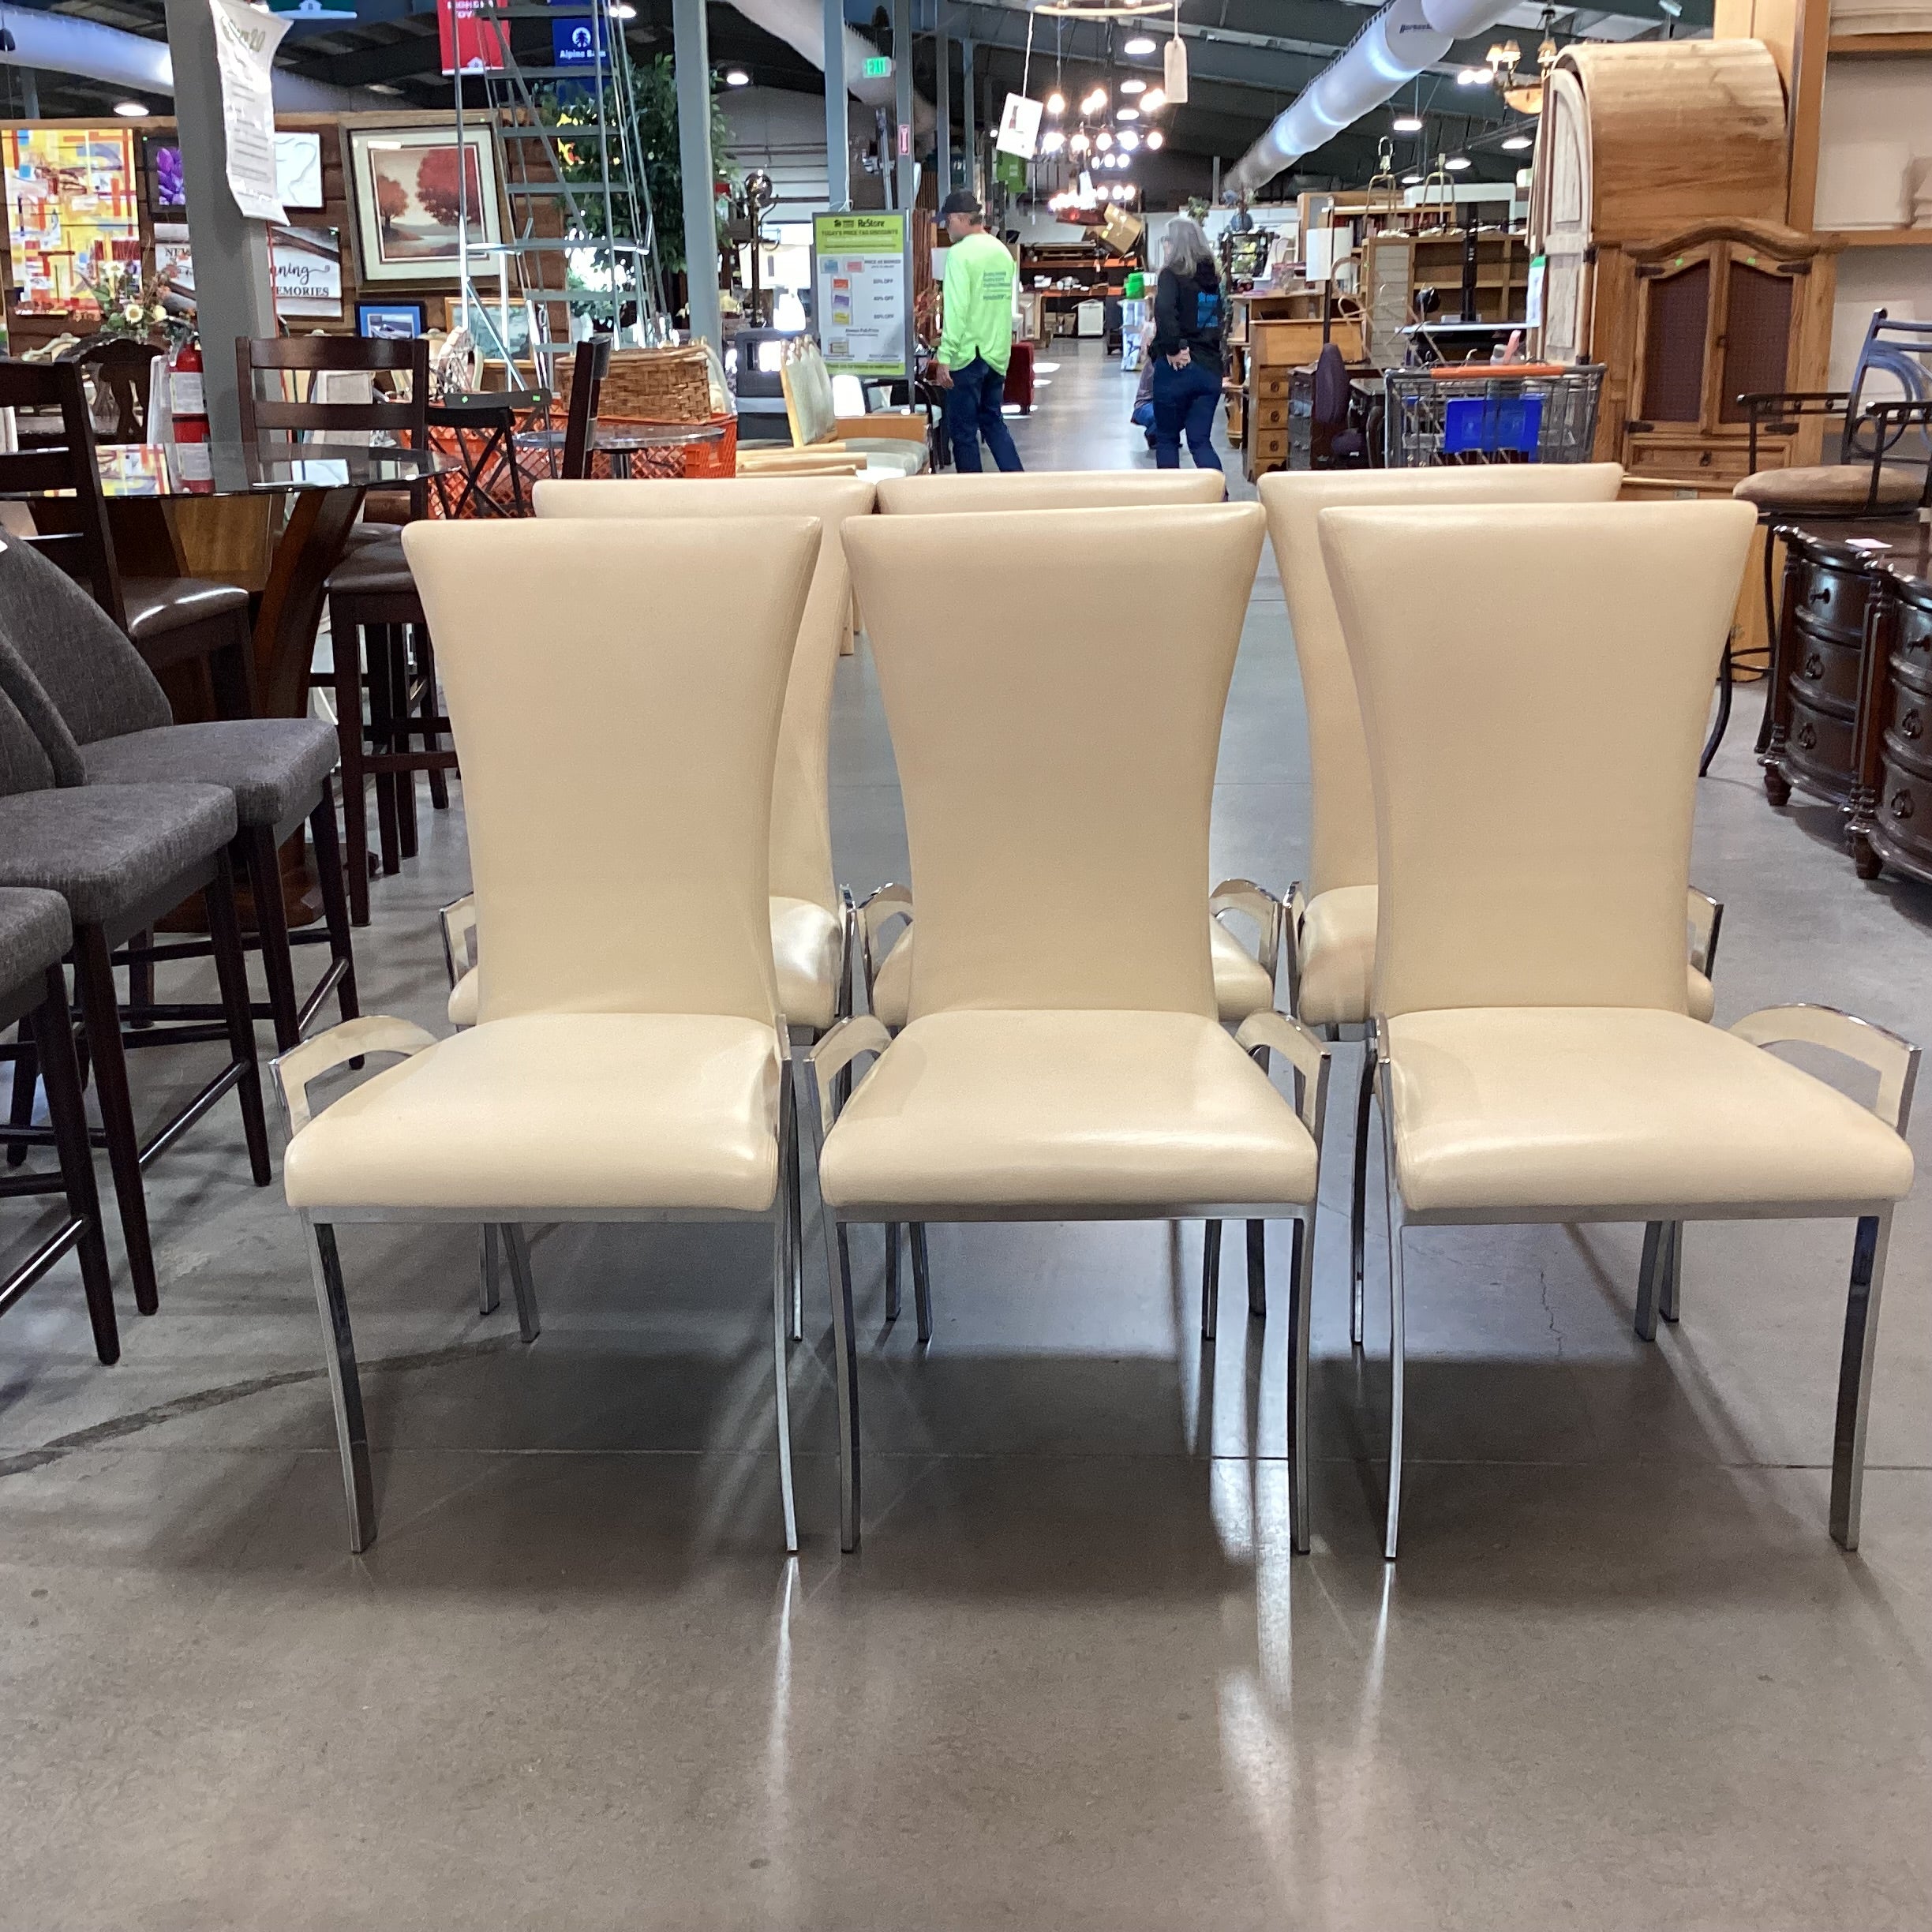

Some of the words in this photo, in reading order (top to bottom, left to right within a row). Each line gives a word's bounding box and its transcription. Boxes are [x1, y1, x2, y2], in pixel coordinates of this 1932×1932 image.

[560, 49, 586, 60] Alpine
[586, 49, 607, 58] Bak
[867, 58, 886, 75] EXIT
[857, 219, 885, 227] ReStore
[272, 286, 330, 297] EMORIES
